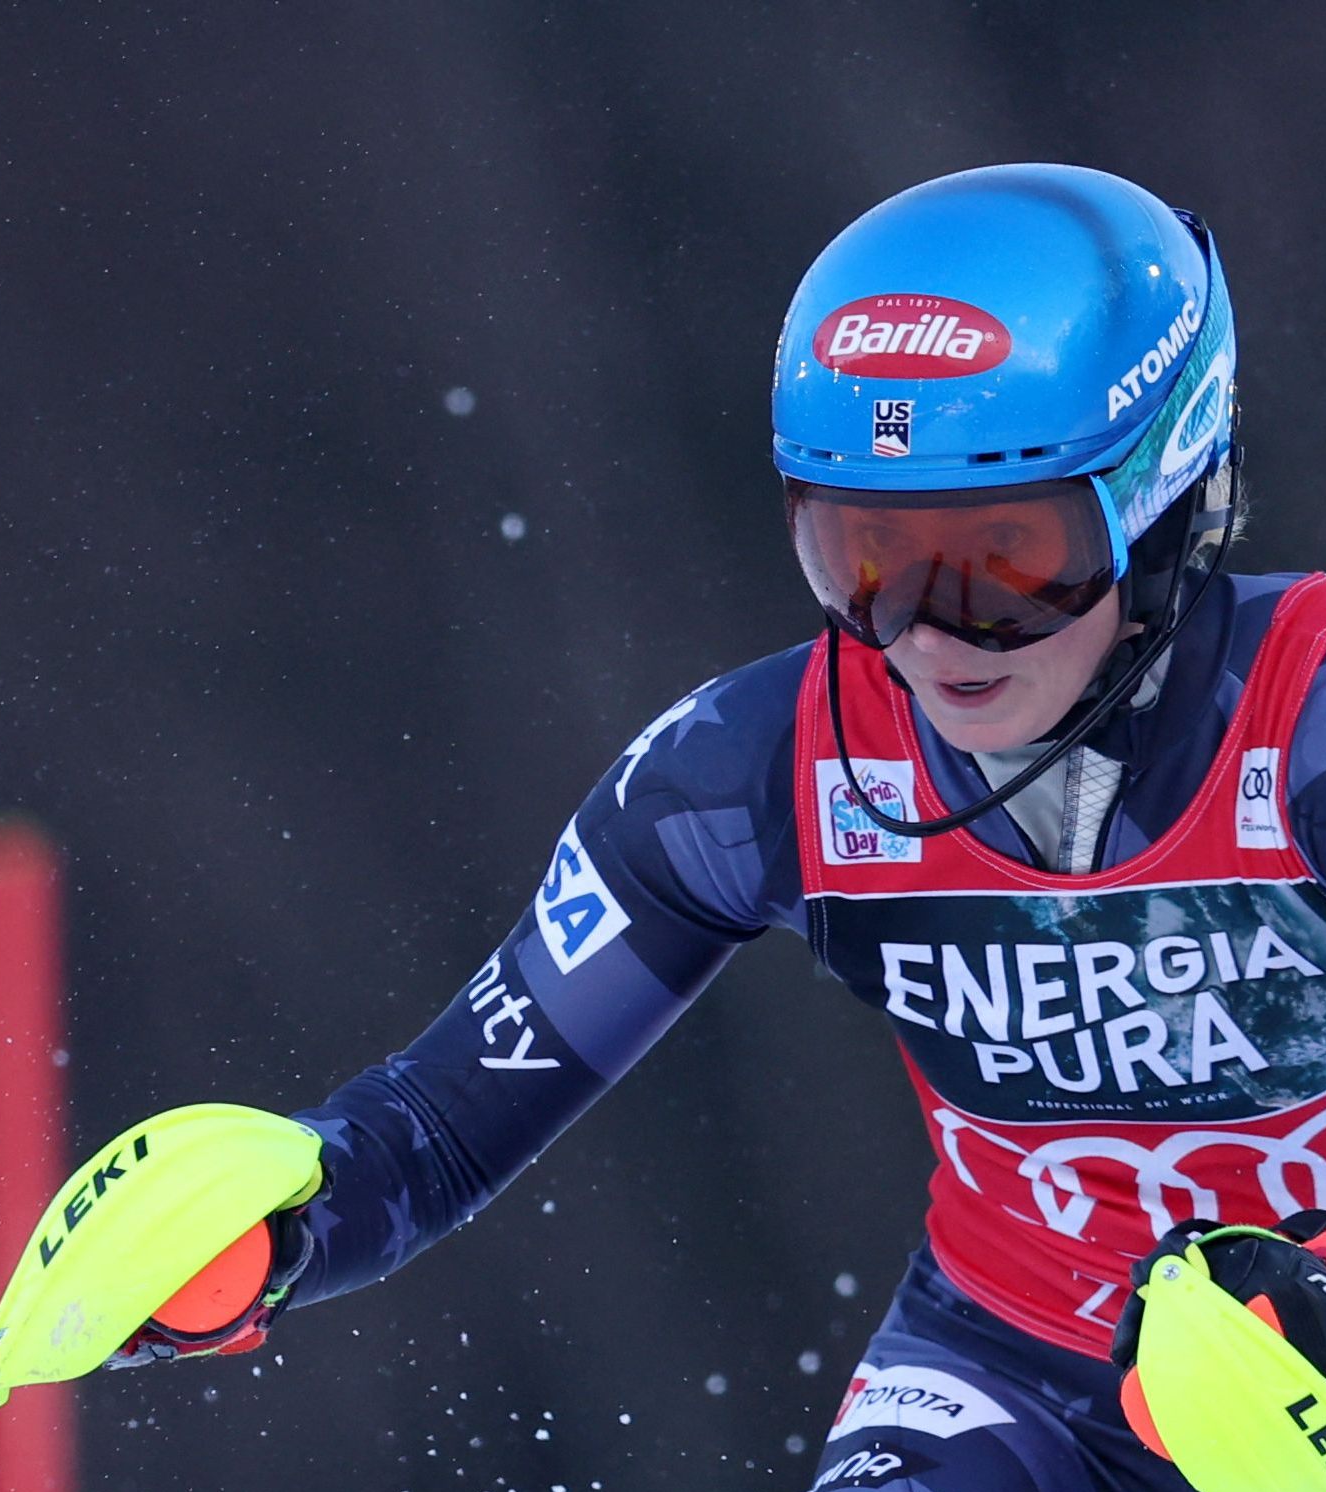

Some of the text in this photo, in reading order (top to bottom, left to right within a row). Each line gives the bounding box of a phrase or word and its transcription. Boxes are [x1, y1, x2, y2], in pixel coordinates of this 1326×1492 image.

[908, 298, 942, 310] 1877
[827, 312, 984, 361] Barilla
[1107, 299, 1201, 422] ATOMIC
[875, 401, 910, 421] US
[843, 831, 878, 855] Day
[879, 924, 1325, 1043] ENERGIA
[971, 990, 1271, 1094] PURA
[1026, 1091, 1229, 1111] PROFESSIONAL SKI WEAR
[38, 1133, 150, 1270] LEKI
[857, 1385, 966, 1419] TOYOTA
